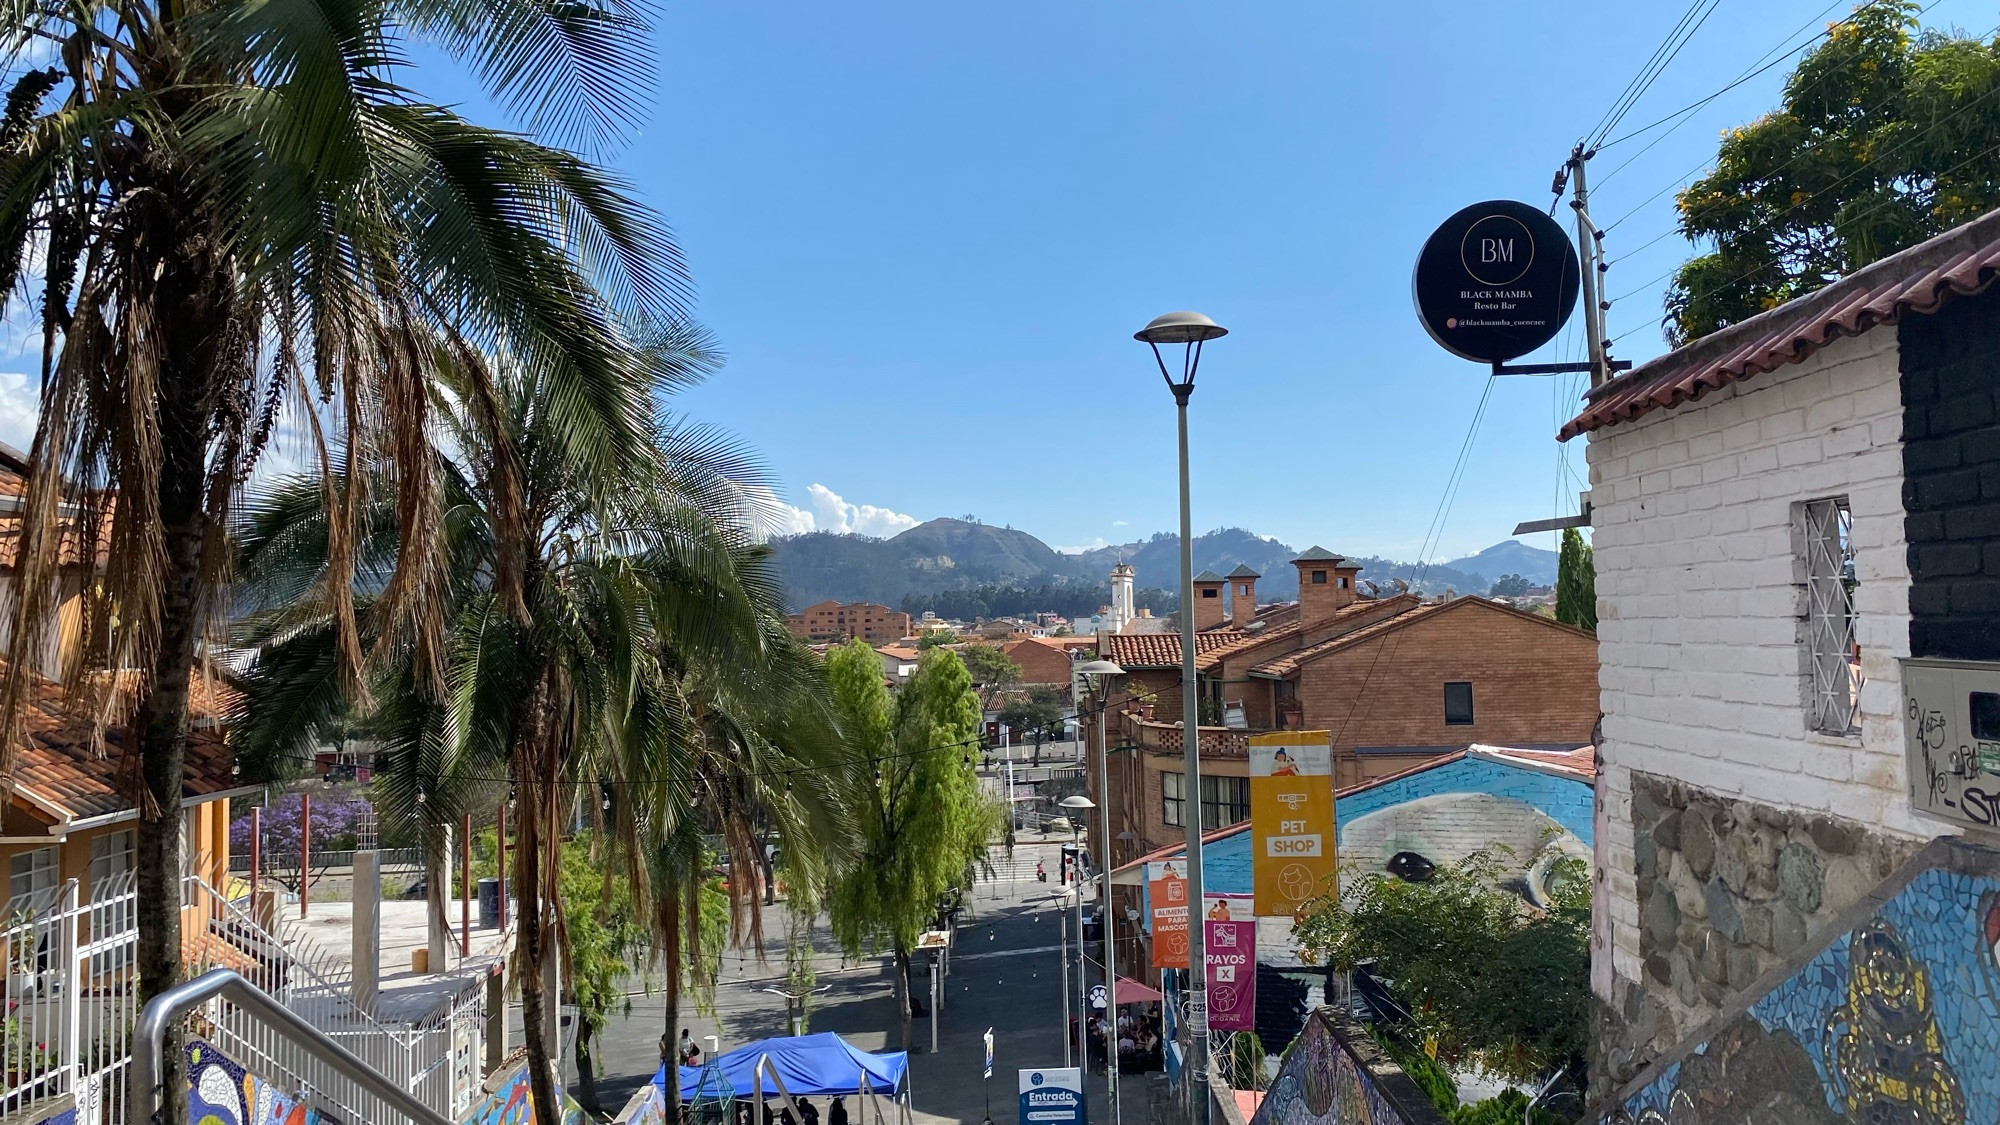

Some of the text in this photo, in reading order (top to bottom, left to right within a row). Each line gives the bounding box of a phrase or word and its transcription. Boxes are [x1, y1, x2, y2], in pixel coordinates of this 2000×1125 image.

[1481, 238, 1514, 263] BM
[1460, 290, 1533, 299] BLACK MAMBA
[1474, 302, 1517, 310] Resto Bar
[1280, 820, 1306, 834] PET
[1273, 839, 1315, 853] SHOP
[1206, 954, 1246, 965] RAYOS
[1221, 969, 1230, 979] X
[1029, 1091, 1073, 1101] Entrada
